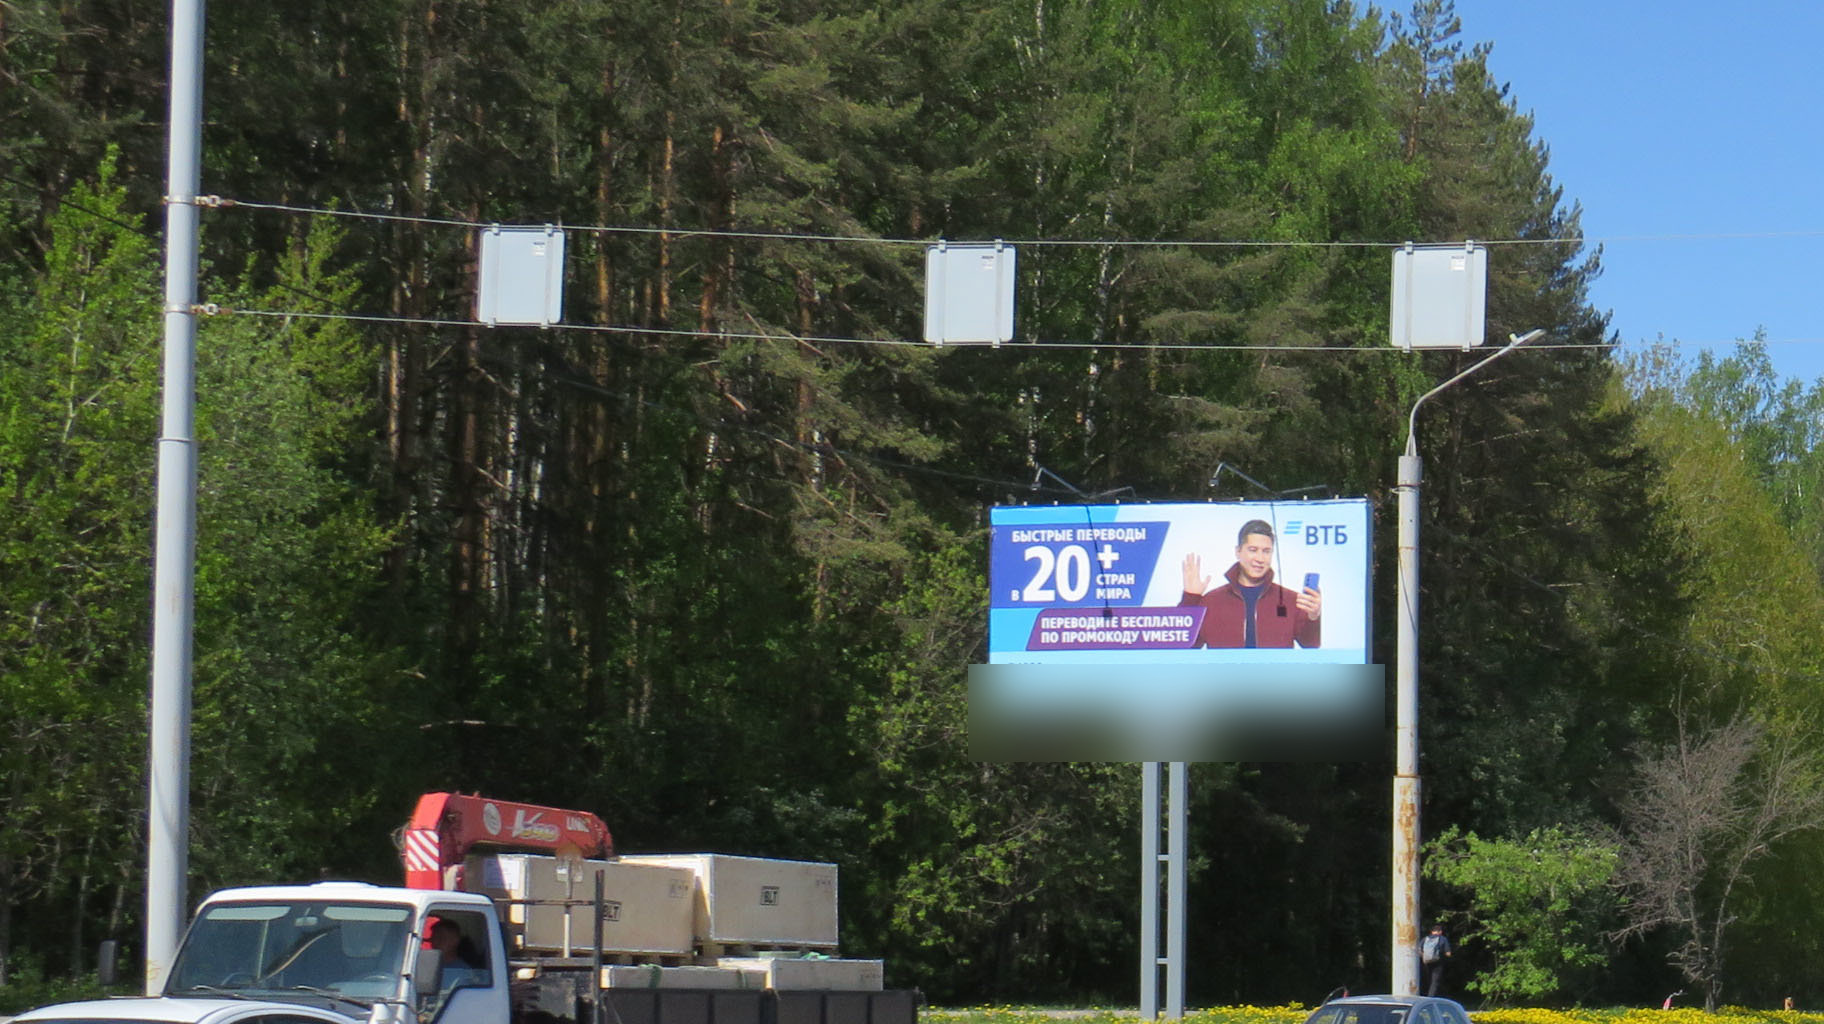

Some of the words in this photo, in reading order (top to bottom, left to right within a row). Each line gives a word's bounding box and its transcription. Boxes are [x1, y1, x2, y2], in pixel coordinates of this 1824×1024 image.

[1012, 529, 1073, 543] БЫСТРЫЕ
[1076, 527, 1147, 543] ПЕРЕВОДЫ
[1305, 524, 1349, 546] ВТБ
[1095, 573, 1135, 585] СТРАН
[1095, 588, 1132, 600] МИРА
[1041, 615, 1118, 630] ПЕРЕВОДИТЕ
[1121, 615, 1193, 628] БЕСПЛАТНО
[1041, 632, 1059, 644] ПО
[1062, 630, 1140, 645] ПРОМОКОДУ
[1142, 630, 1190, 642] VMESTE
